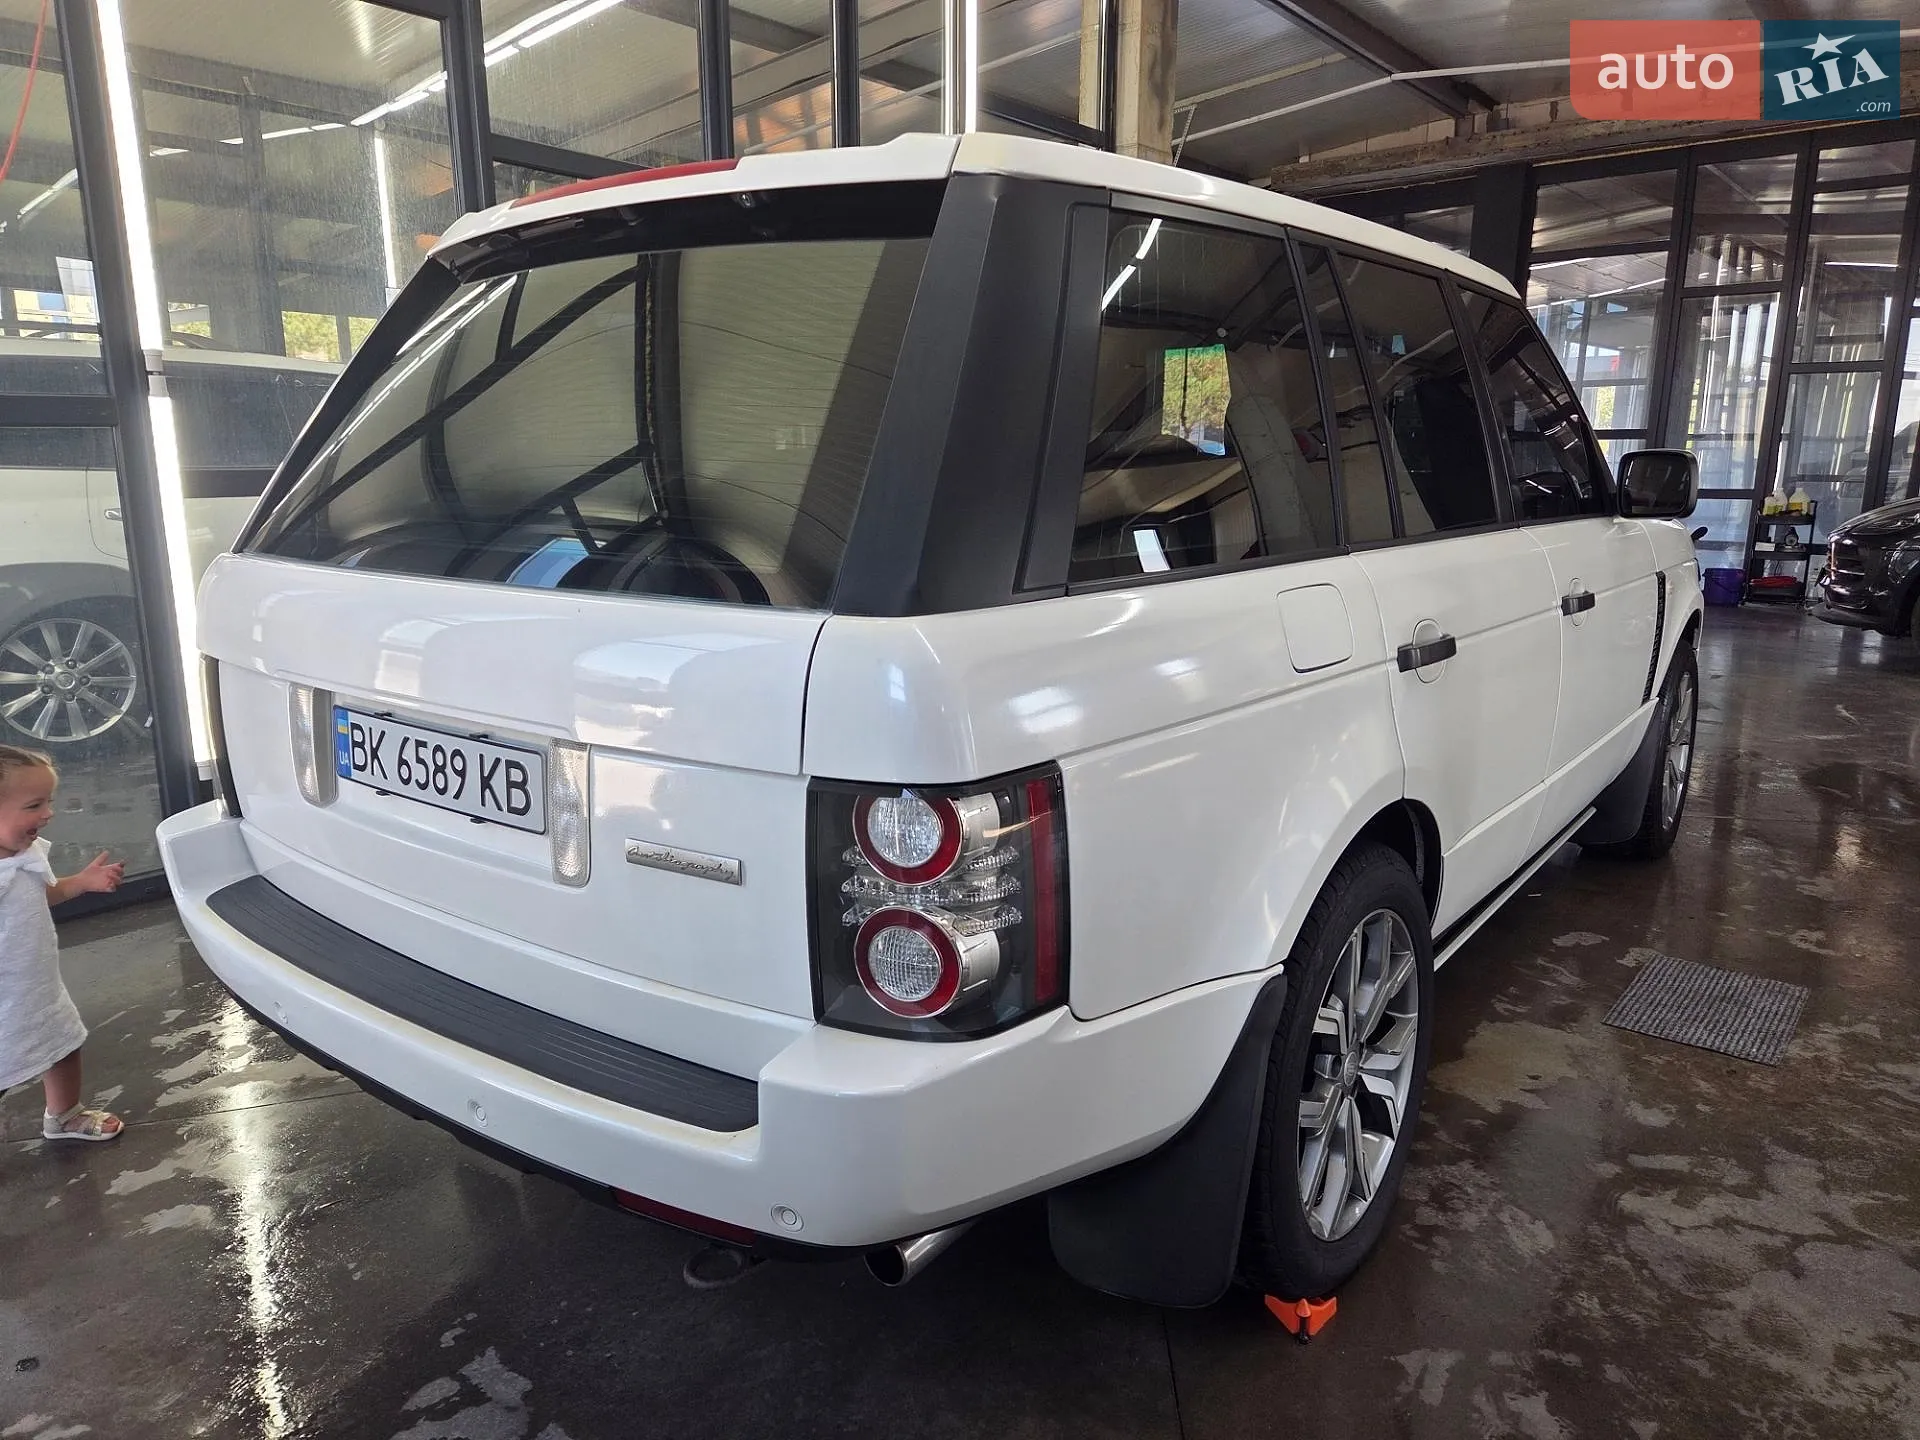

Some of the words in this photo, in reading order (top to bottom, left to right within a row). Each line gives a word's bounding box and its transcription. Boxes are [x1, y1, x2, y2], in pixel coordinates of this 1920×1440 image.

[339, 749, 351, 768] UA
[350, 722, 389, 781] BK
[397, 736, 468, 801] 6589
[479, 753, 533, 817] KB
